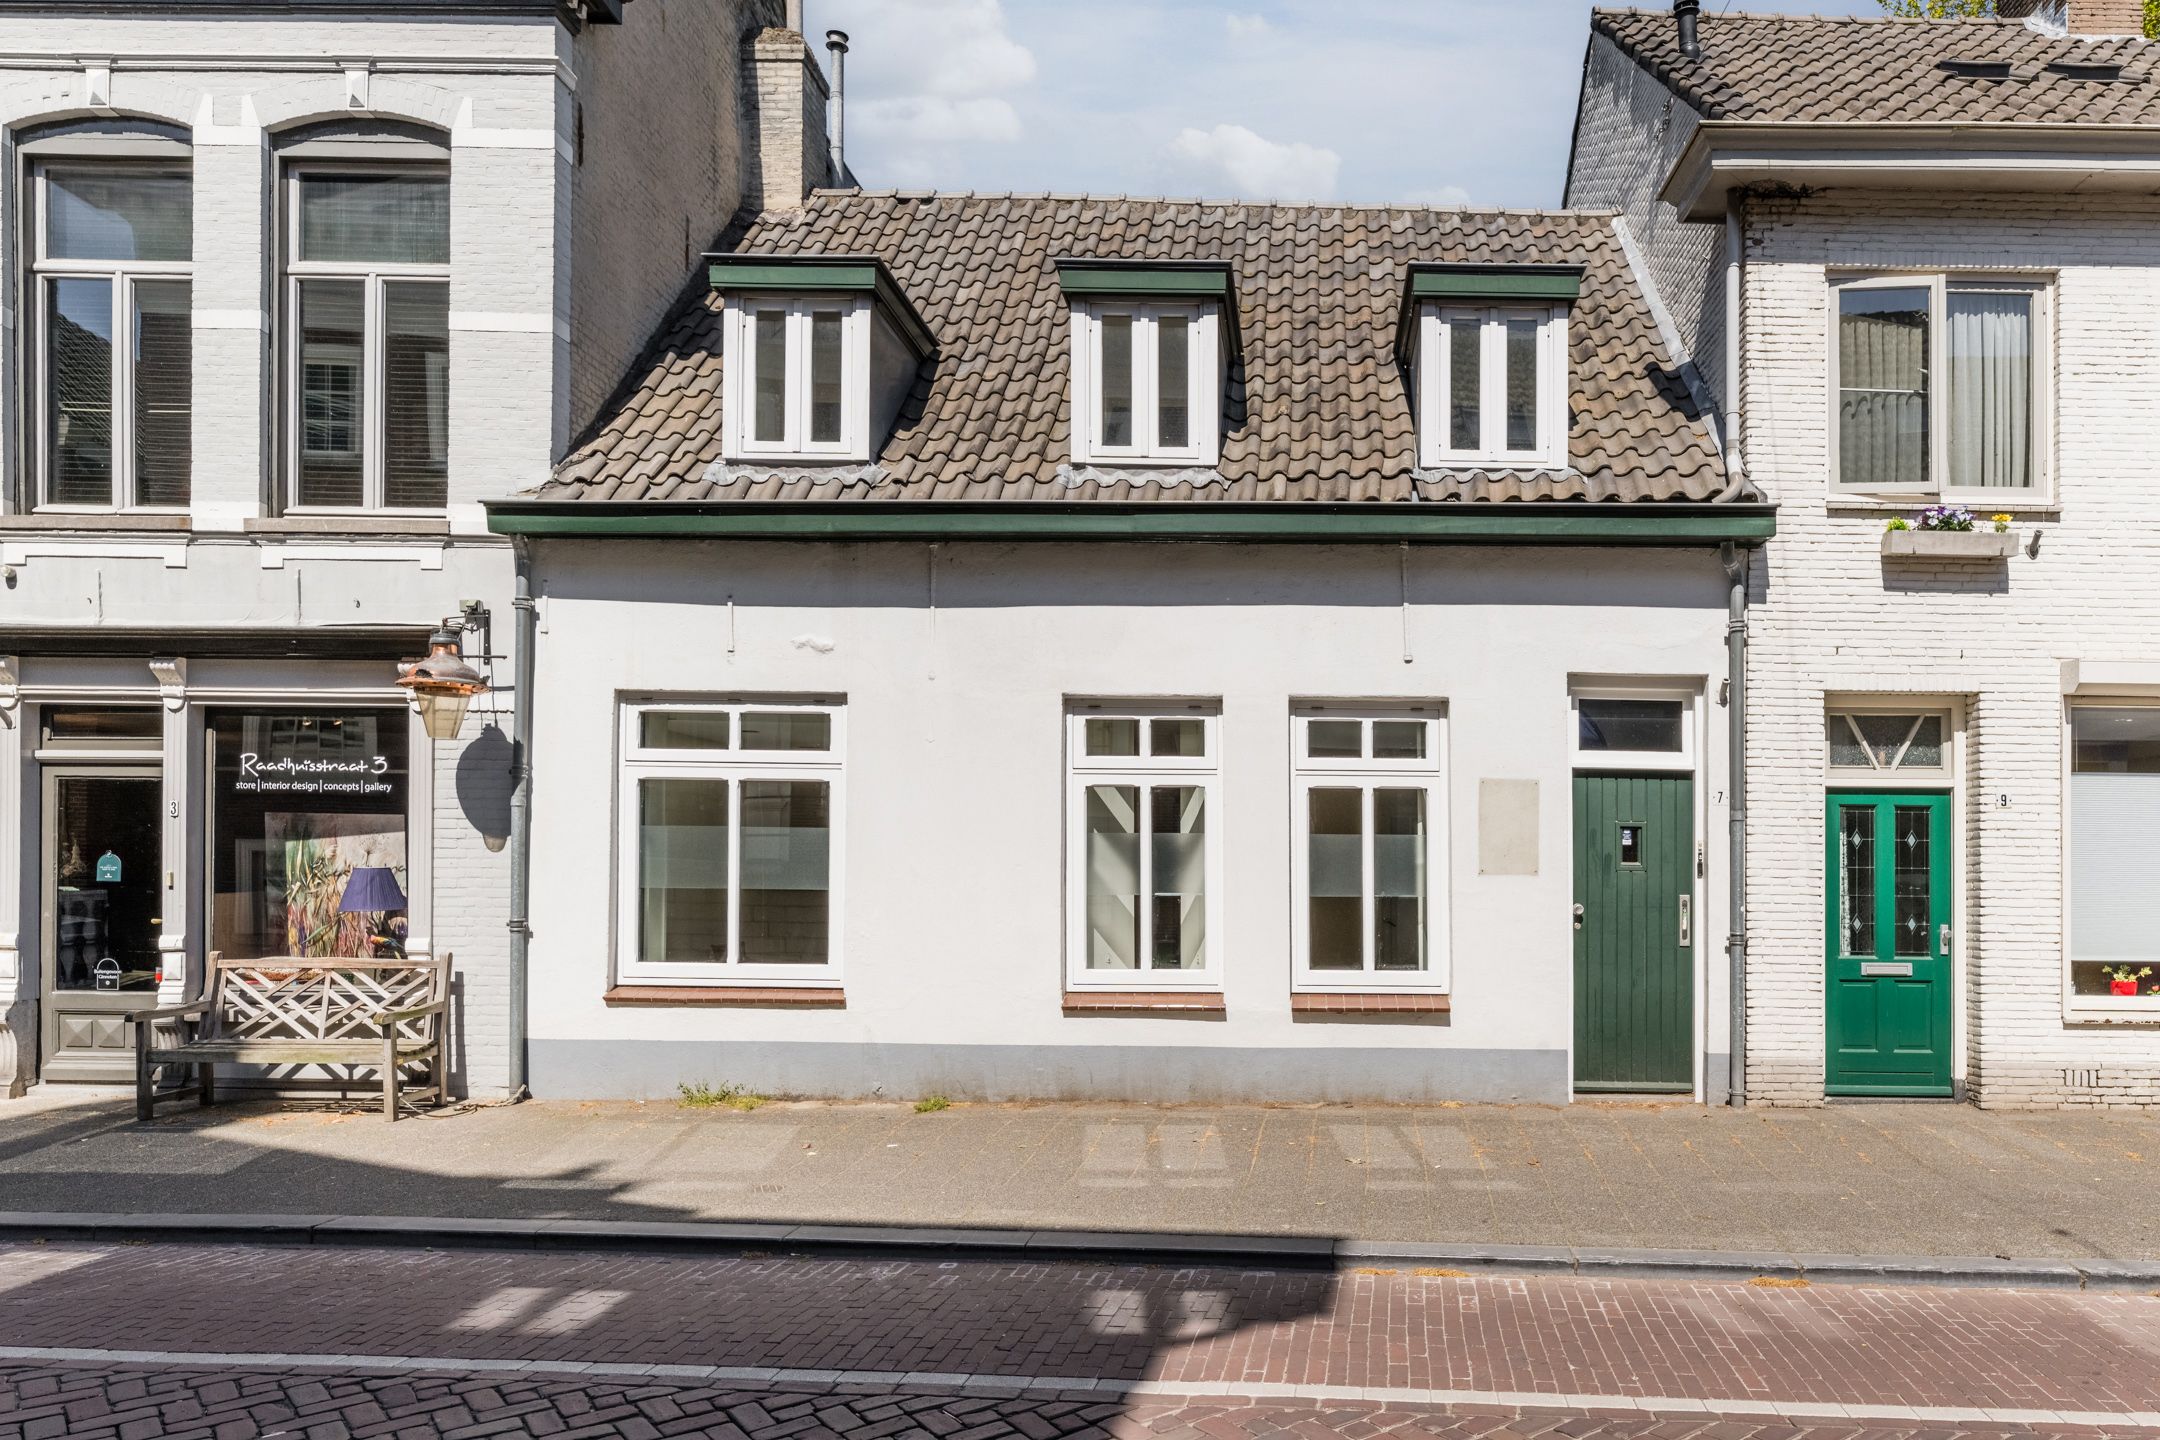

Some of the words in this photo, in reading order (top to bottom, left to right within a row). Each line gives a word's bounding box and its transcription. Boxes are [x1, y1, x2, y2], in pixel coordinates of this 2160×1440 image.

[370, 756, 388, 774] 3
[236, 782, 256, 790] store
[261, 781, 291, 790] interior
[291, 781, 319, 792] design
[323, 782, 360, 793] concepts
[364, 782, 392, 793] gallery
[1717, 791, 1724, 804] 7
[2000, 794, 2007, 807] 9
[170, 801, 177, 815] 3
